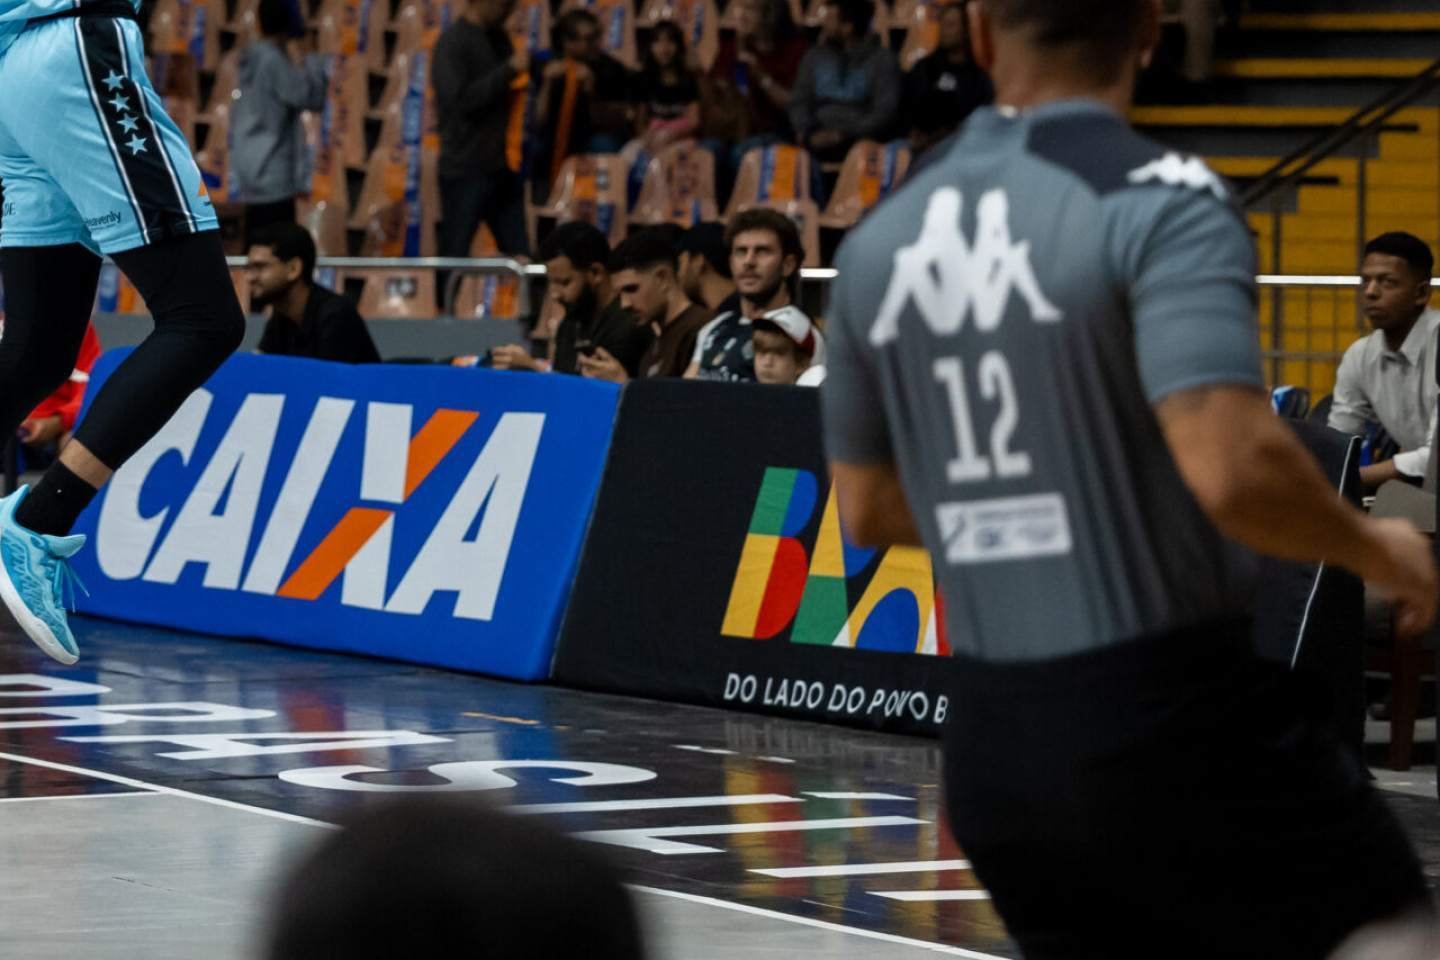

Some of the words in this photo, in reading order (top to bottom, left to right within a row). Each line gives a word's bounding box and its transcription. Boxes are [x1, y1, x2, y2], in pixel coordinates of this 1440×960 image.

[932, 349, 1032, 484] 12
[96, 387, 547, 620] CAIXA
[724, 672, 757, 702] DO
[763, 677, 824, 708] LADO
[827, 684, 864, 714] DO
[866, 689, 928, 720] POVO
